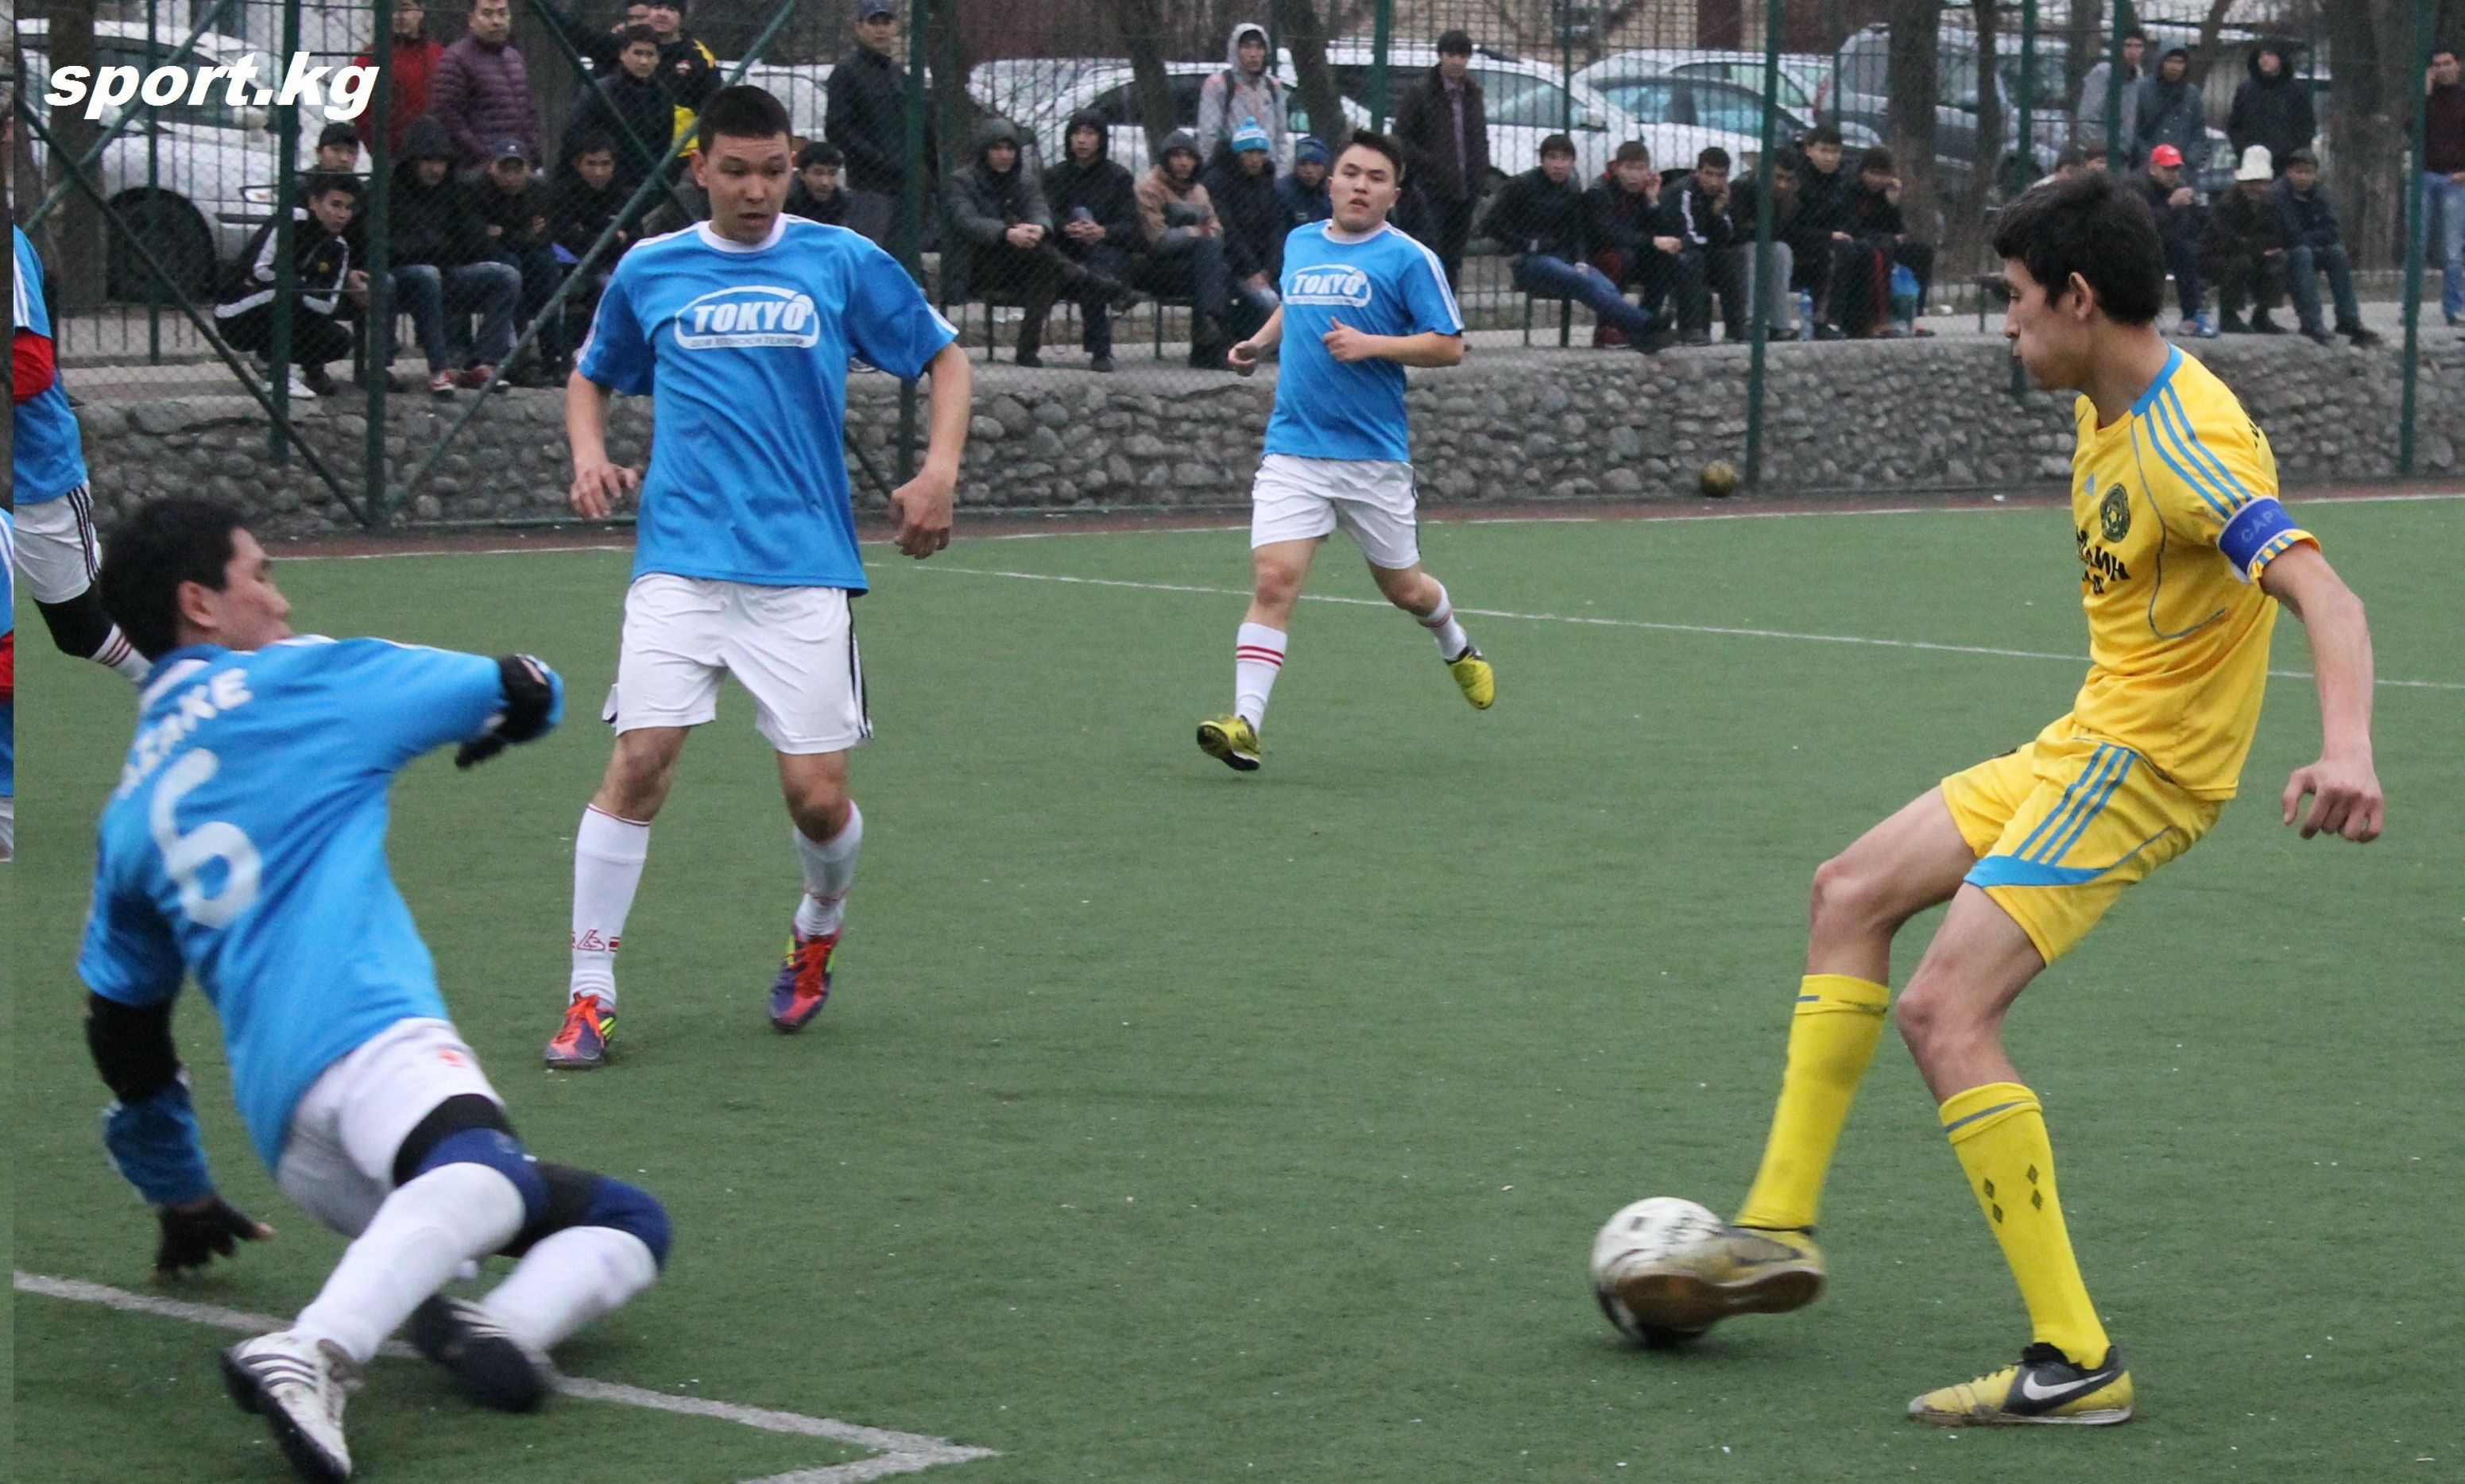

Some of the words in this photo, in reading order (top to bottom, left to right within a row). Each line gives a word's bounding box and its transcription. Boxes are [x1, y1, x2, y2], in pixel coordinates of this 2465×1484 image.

[1291, 273, 1361, 296] TOKYO
[694, 300, 808, 334] TOKYO
[150, 748, 262, 930] 6
